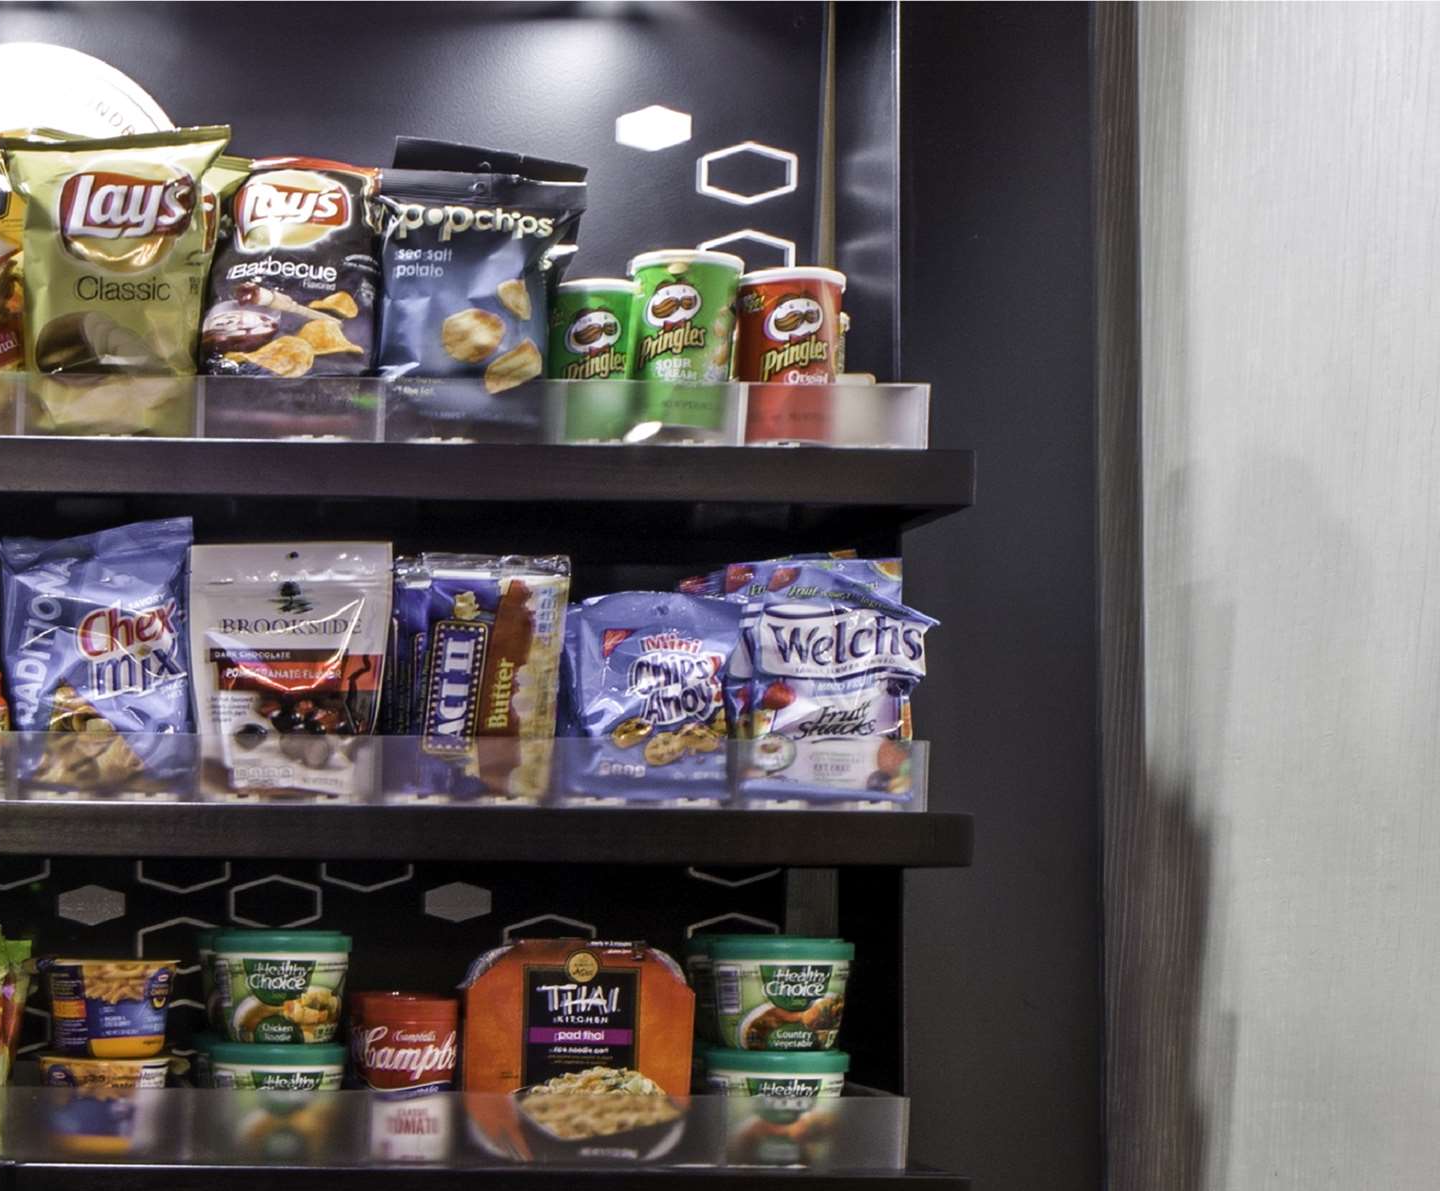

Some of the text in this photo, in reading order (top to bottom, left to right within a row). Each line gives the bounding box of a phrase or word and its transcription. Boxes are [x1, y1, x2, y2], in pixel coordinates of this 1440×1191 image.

[398, 203, 555, 241] popchips
[228, 256, 337, 281] Barbecue
[395, 263, 444, 278] potato
[76, 275, 170, 302] Classic
[641, 321, 706, 366] Pringles
[566, 350, 627, 380] Pringles
[764, 335, 828, 380] Pringles
[78, 597, 177, 659] Chex
[221, 617, 363, 634] BROOKSIDE
[641, 632, 702, 654] Mini
[768, 614, 923, 667] Welch's
[214, 651, 291, 659] DARK CHOCOLATE
[94, 645, 184, 694] mix
[629, 655, 711, 695] Chips
[487, 657, 515, 730] Butter
[816, 699, 872, 724] Fruit
[792, 719, 877, 740] Snacks
[254, 960, 312, 979] Healthy
[774, 965, 830, 983] Healthy
[248, 973, 306, 990] Choice
[762, 980, 825, 997] Choice
[537, 983, 620, 1016] THAI
[262, 1023, 294, 1032] Chicken
[554, 1015, 609, 1024] KITCHEN
[555, 1030, 605, 1042] pad thai
[776, 1029, 813, 1041] Country
[263, 1072, 319, 1090] Healthy
[760, 1079, 820, 1097] Healthy
